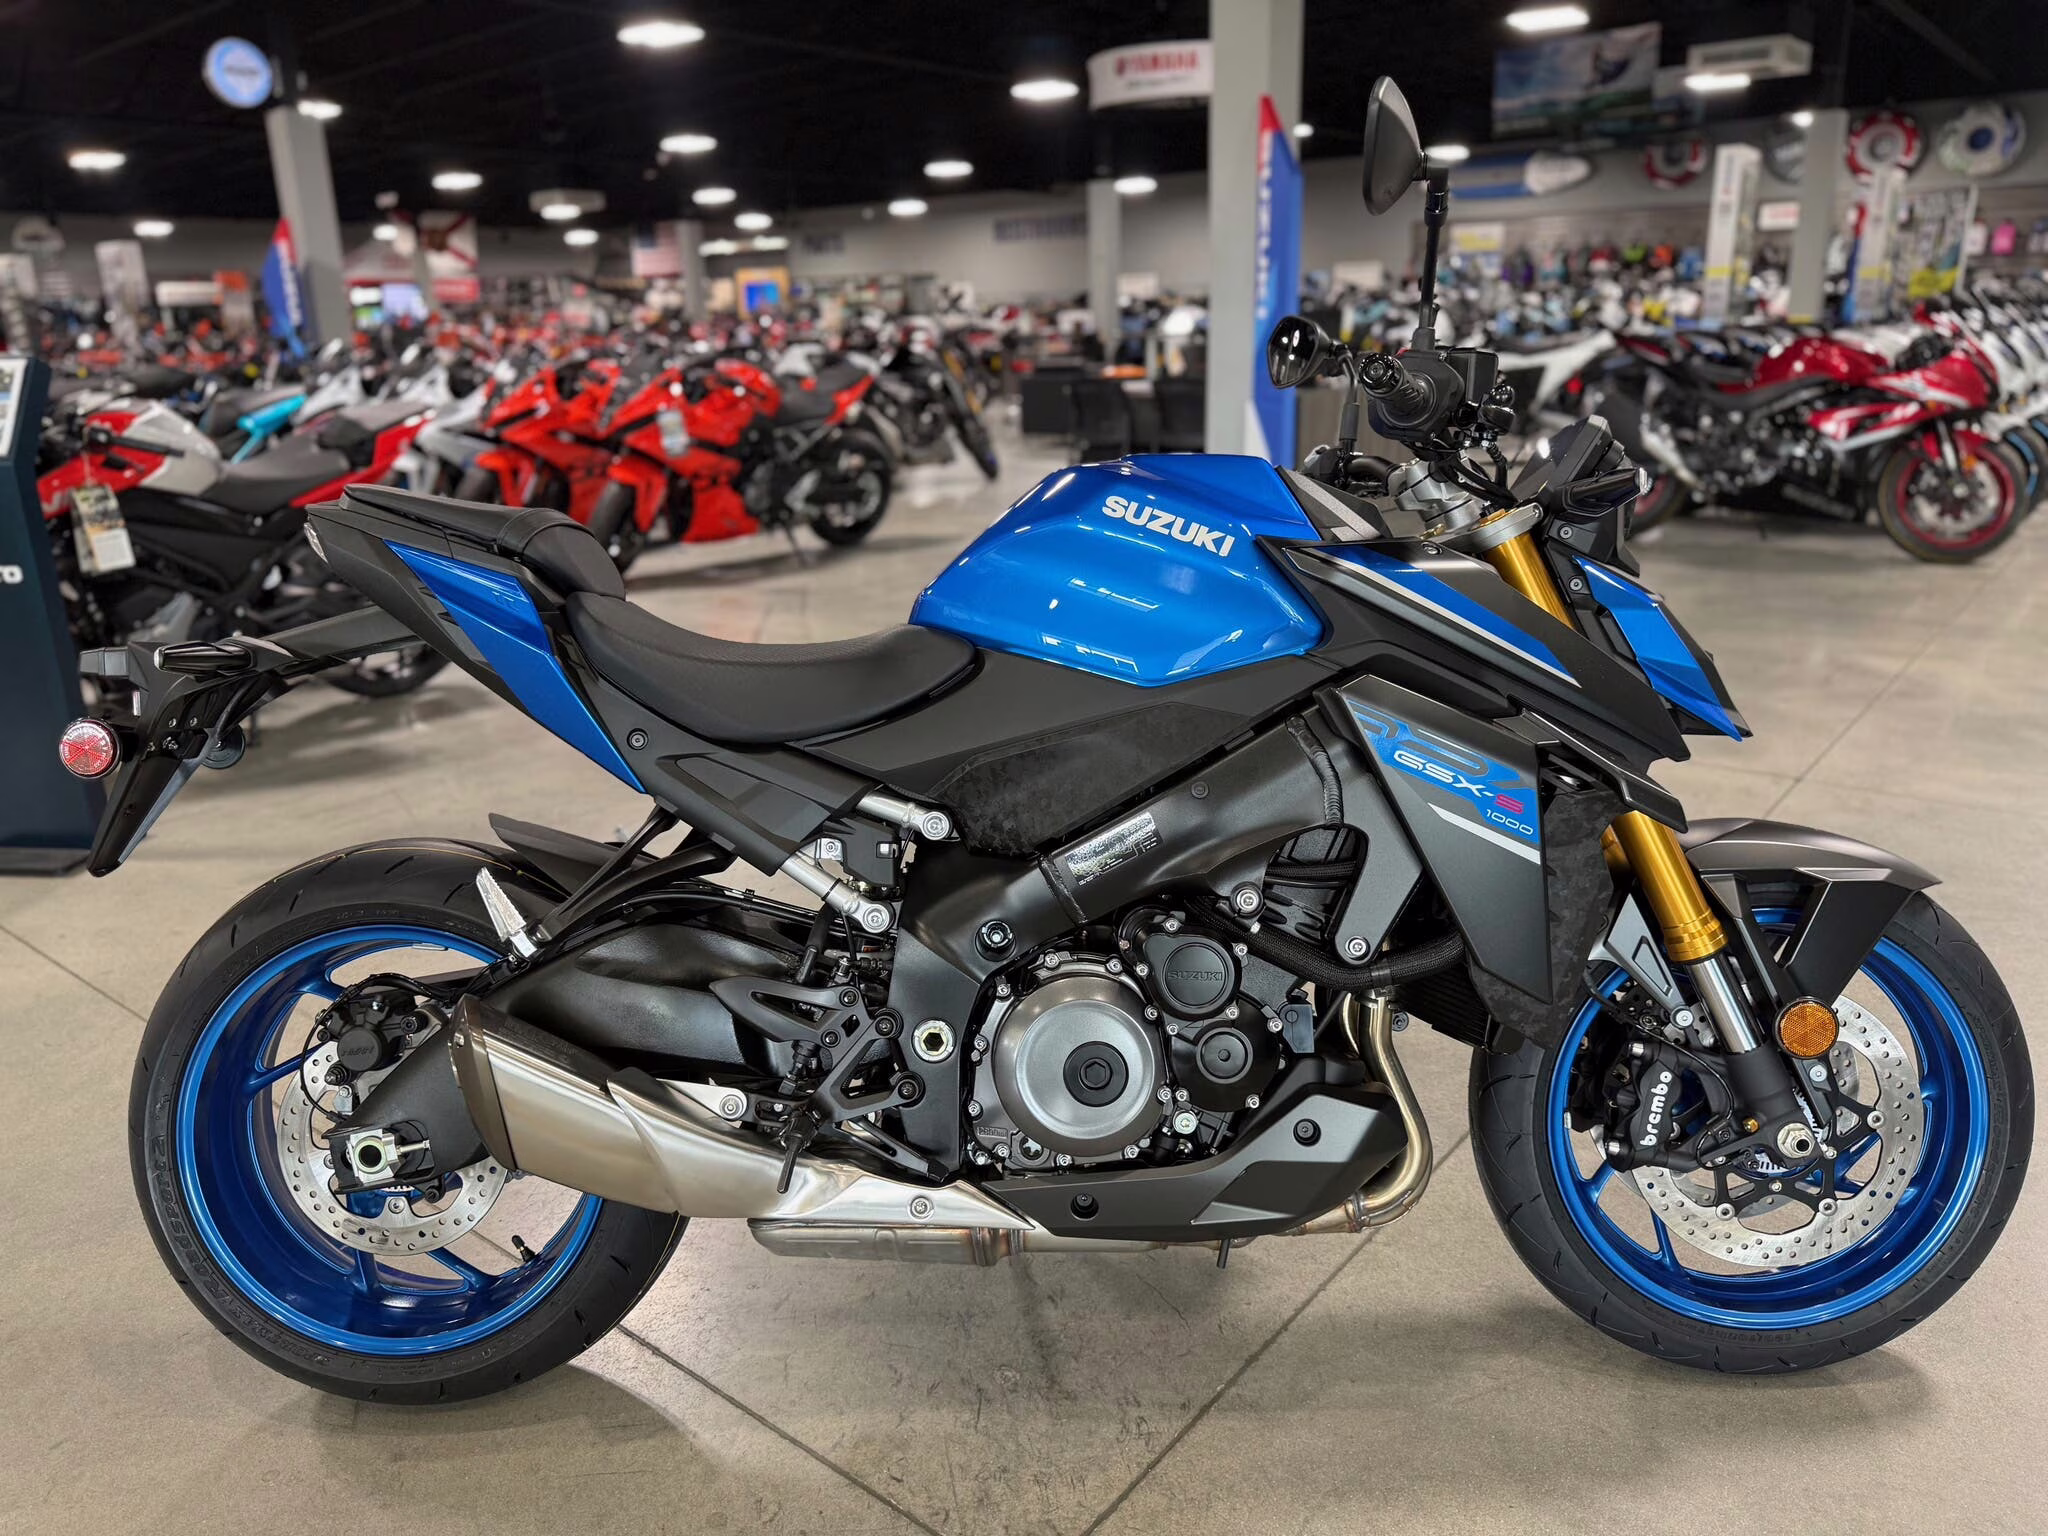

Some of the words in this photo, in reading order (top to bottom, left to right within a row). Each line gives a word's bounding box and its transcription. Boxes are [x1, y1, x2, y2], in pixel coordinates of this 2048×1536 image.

[1102, 495, 1235, 557] SUZUKI
[1393, 750, 1525, 815] GSX-S
[1486, 808, 1534, 835] 1000
[1167, 970, 1224, 981] SUZUKI
[1639, 1071, 1673, 1146] brembo
